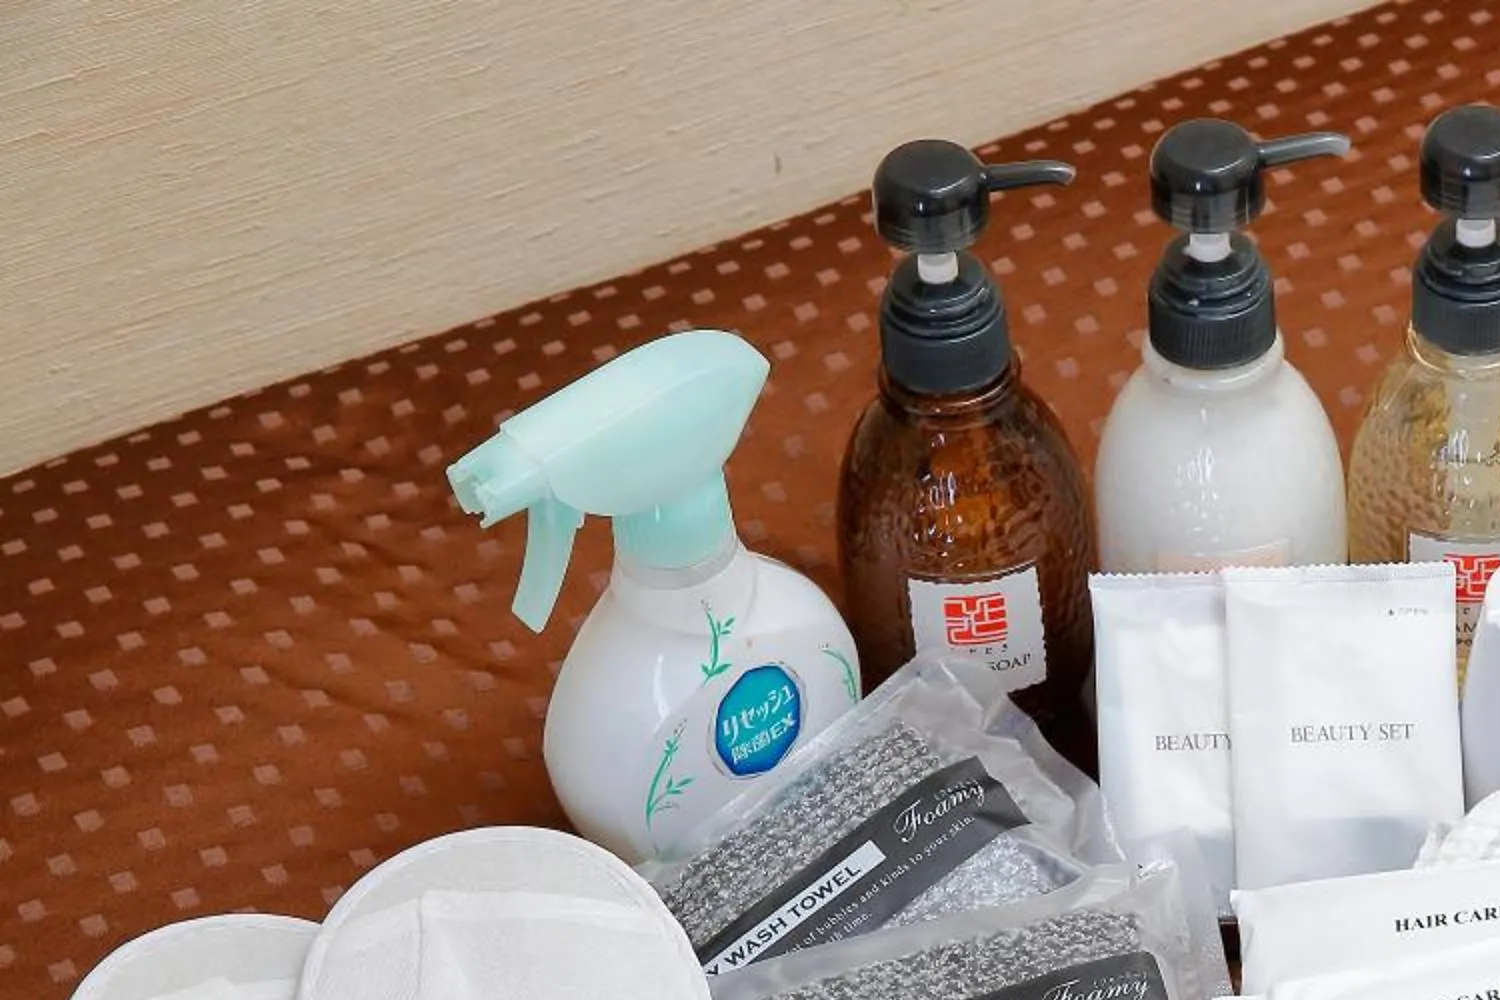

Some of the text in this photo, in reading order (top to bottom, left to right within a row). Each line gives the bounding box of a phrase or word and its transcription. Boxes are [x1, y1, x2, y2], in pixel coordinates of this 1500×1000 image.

[722, 685, 796, 747] リセッシュ
[1155, 733, 1232, 750] BEAUTY
[1290, 723, 1415, 743] BEAUTY SET
[893, 783, 985, 844] Foamy
[724, 866, 861, 966] WASH TOWEL
[803, 931, 817, 945] of
[815, 902, 859, 935] bubbles
[858, 883, 879, 903] and
[879, 864, 910, 887] kinds
[923, 833, 948, 857] your
[1395, 913, 1448, 933] HAIR
